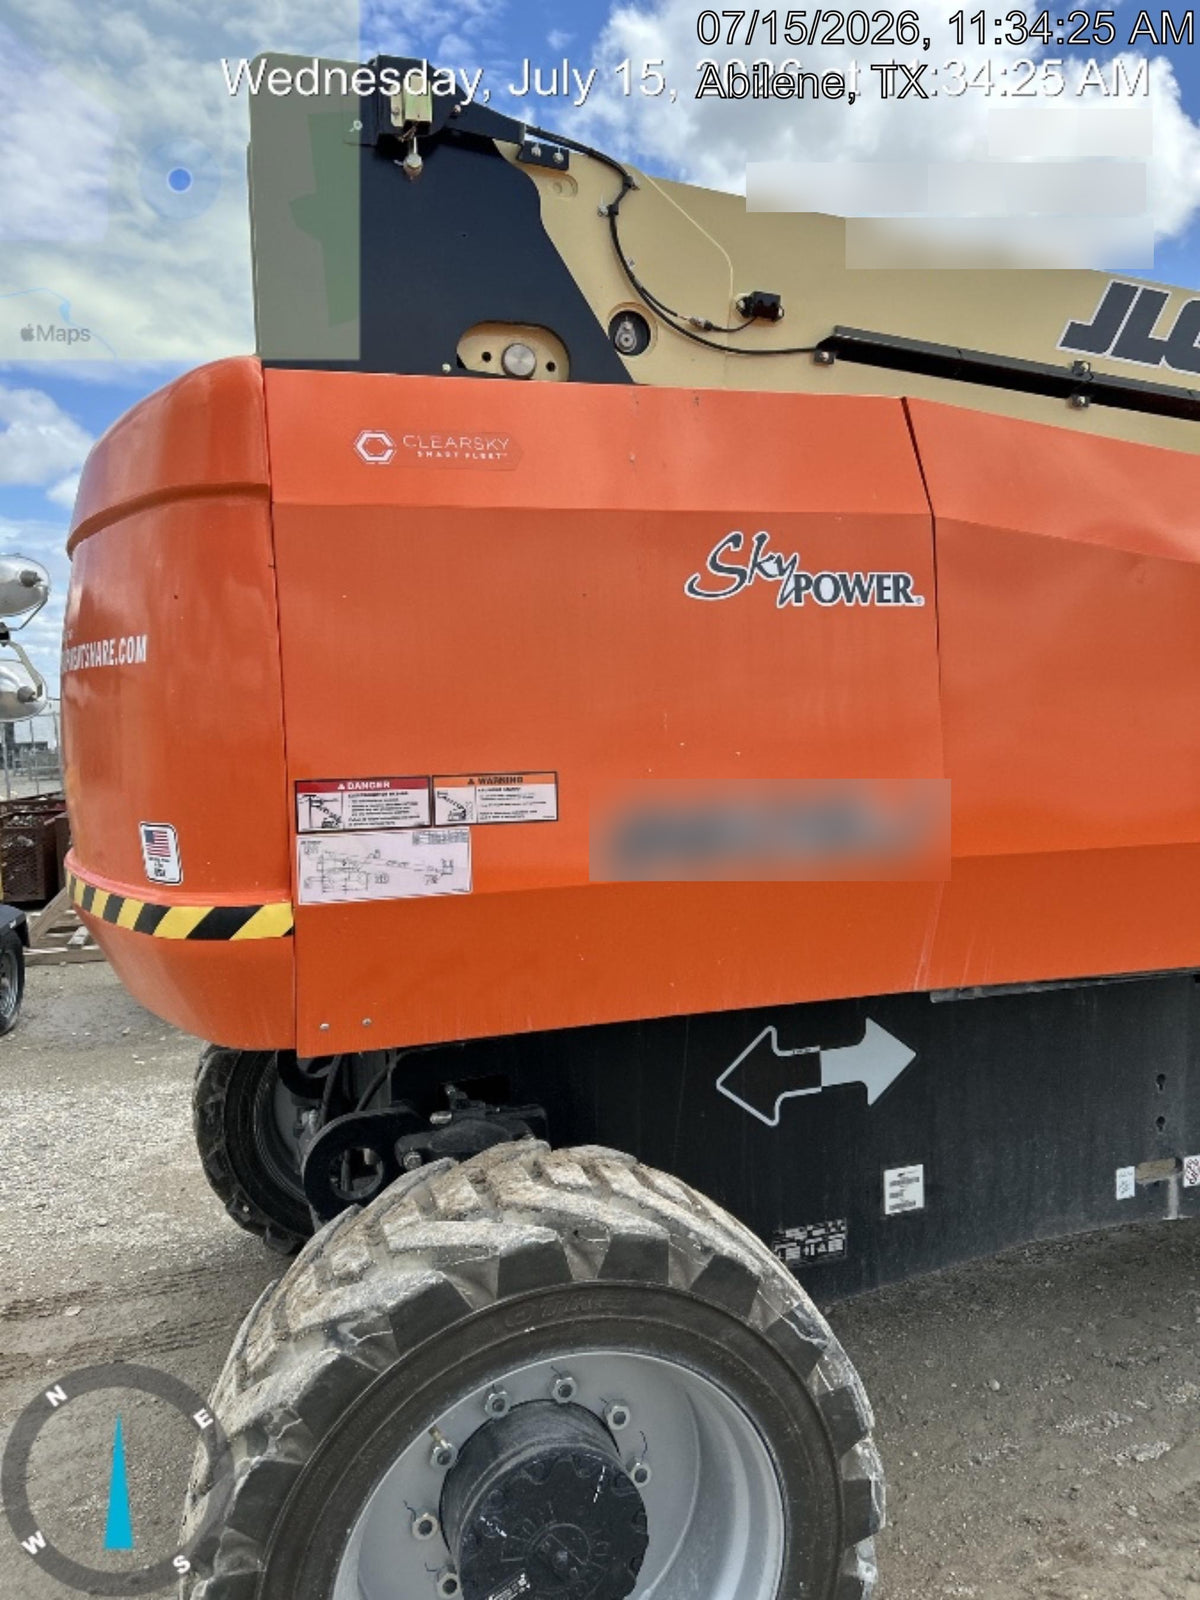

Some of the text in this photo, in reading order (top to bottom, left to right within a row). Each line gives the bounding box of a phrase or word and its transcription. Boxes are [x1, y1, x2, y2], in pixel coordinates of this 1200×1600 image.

[402, 434, 510, 451] CLEARSKY
[684, 531, 916, 609] Sky POWER
[346, 780, 391, 791] DANGER
[477, 776, 524, 786] WARNING
